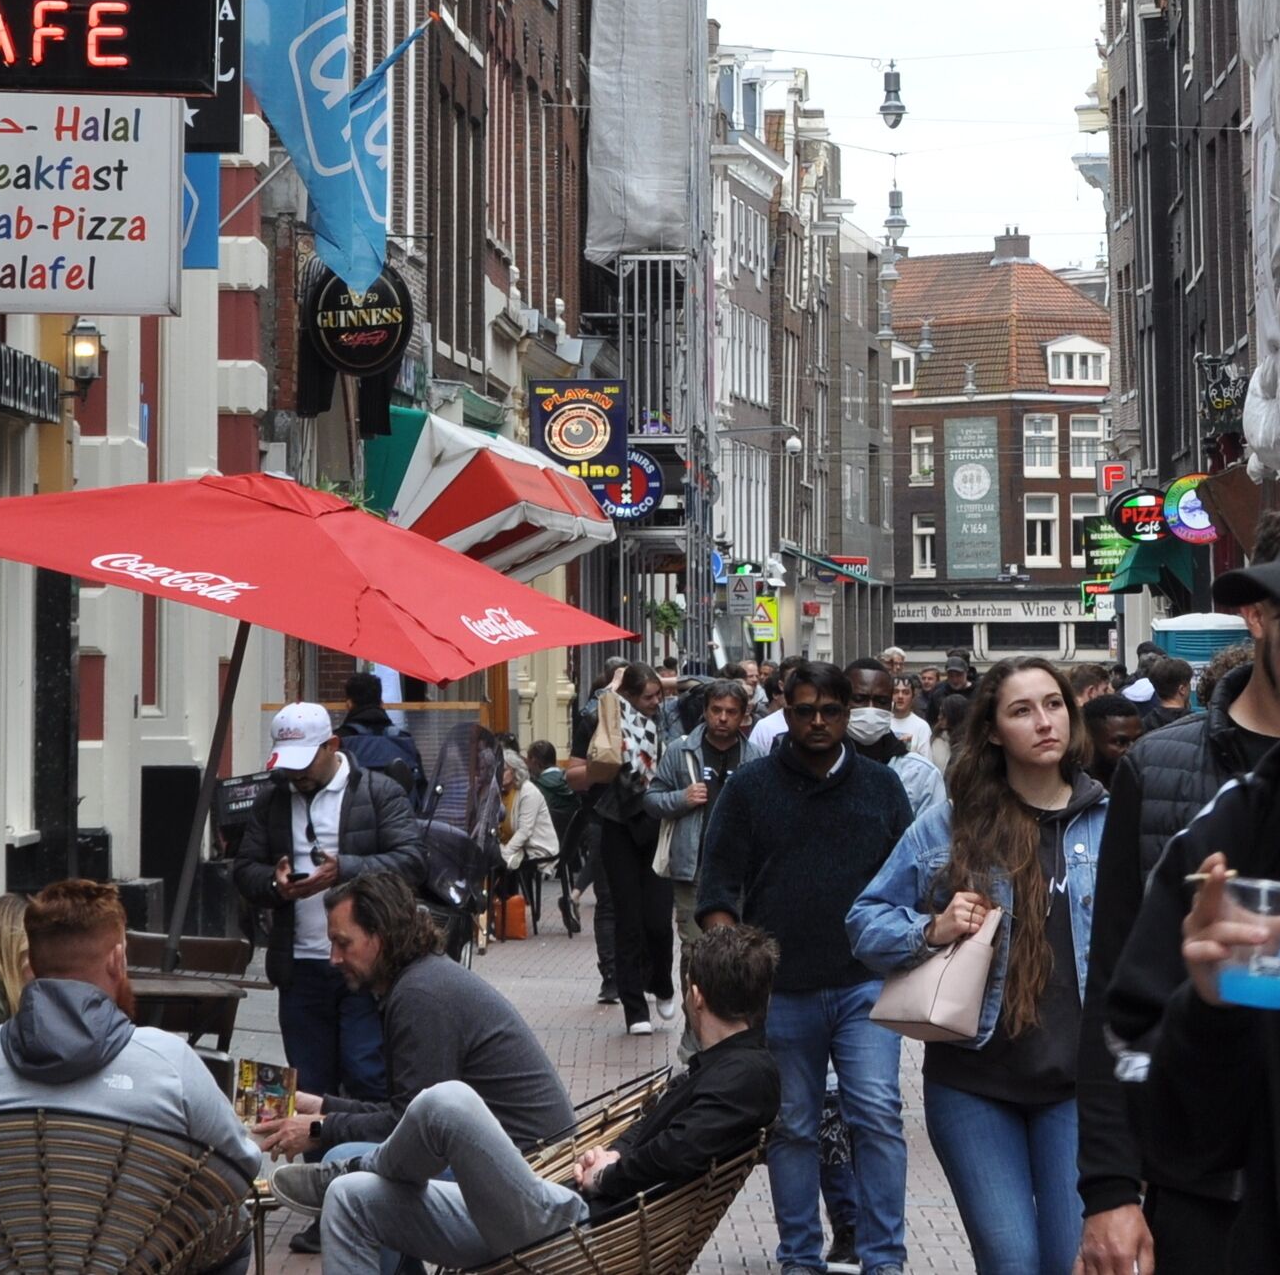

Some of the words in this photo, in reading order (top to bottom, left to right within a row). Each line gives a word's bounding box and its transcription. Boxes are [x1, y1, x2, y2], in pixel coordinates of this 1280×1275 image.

[54, 105, 141, 143] Halal
[316, 307, 404, 329] GUINNESS
[541, 388, 614, 412] PLAY-IN
[1103, 464, 1126, 492] F
[601, 495, 654, 518] TOBACCO
[1121, 507, 1165, 524] PIZZ
[1020, 601, 1057, 617] Wine
